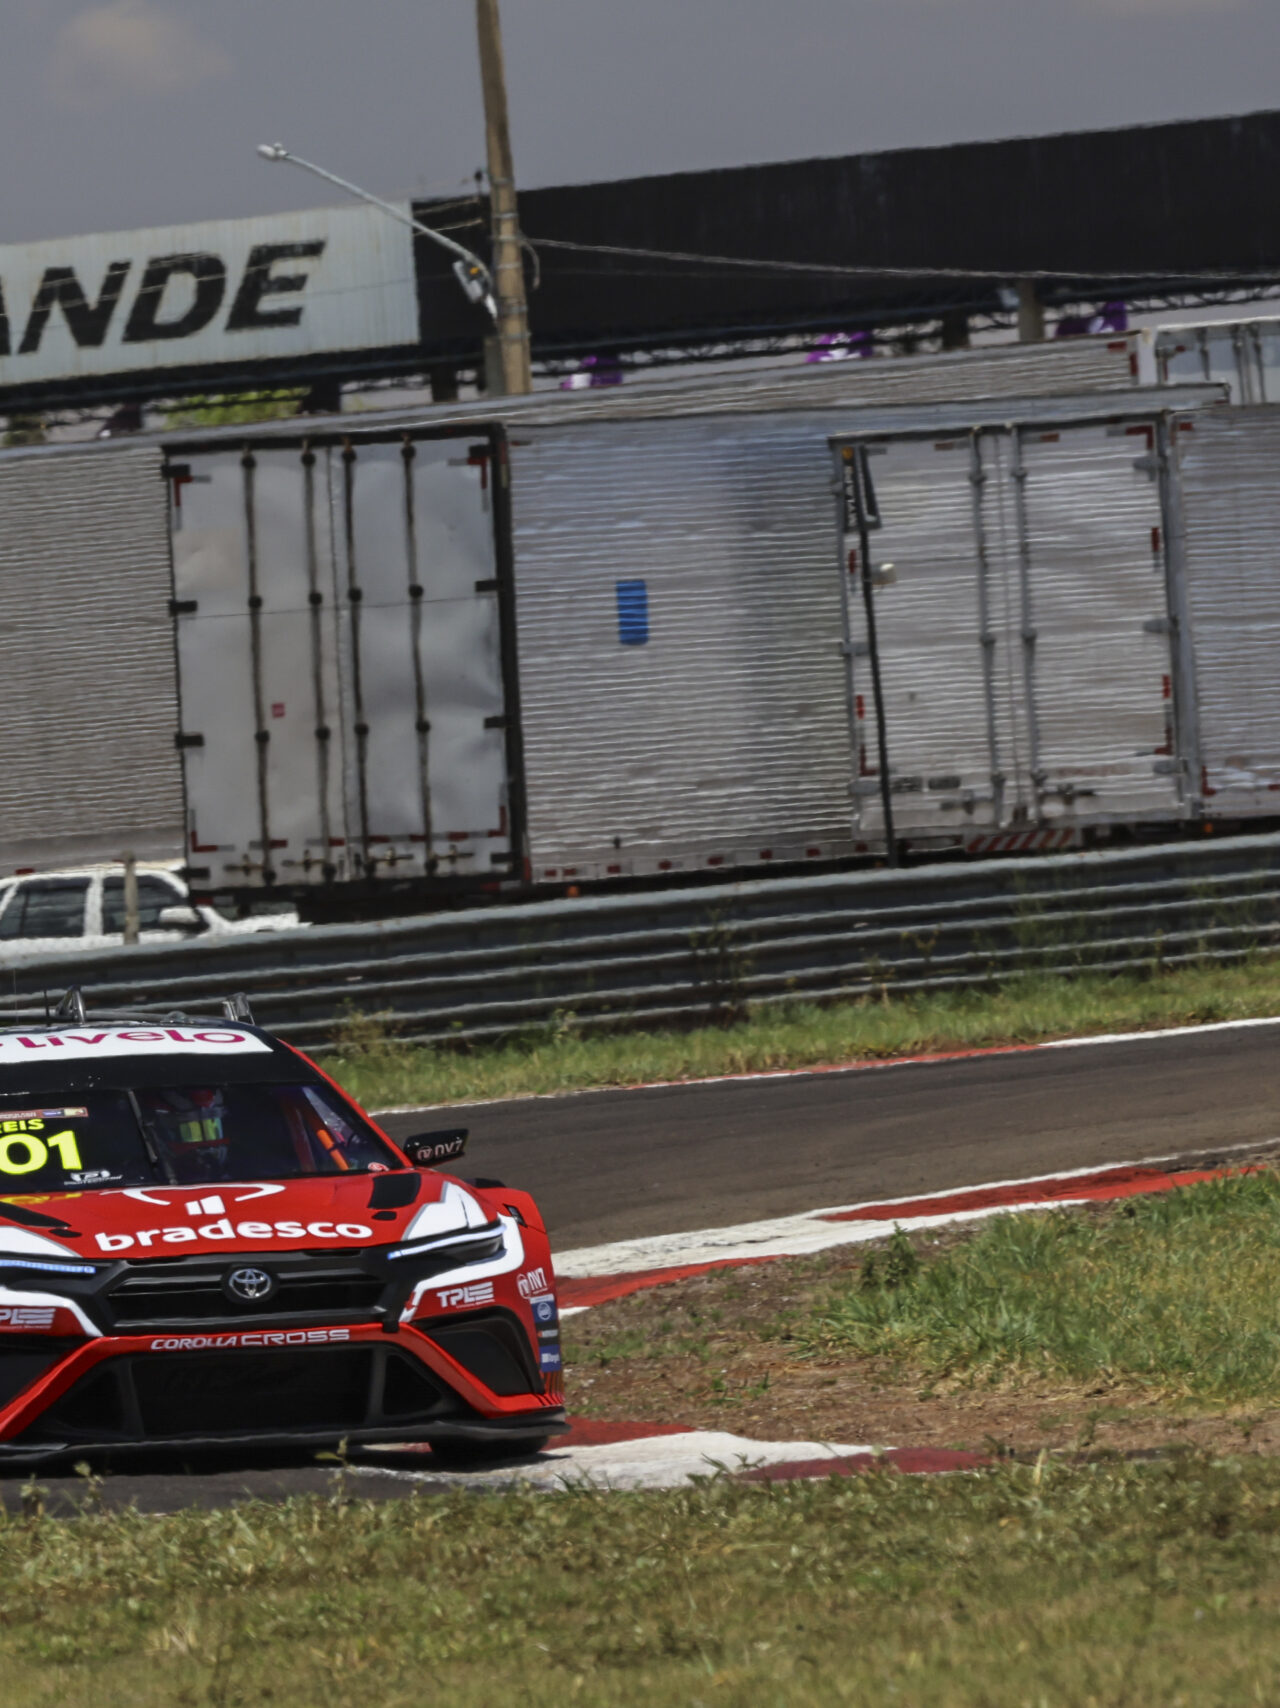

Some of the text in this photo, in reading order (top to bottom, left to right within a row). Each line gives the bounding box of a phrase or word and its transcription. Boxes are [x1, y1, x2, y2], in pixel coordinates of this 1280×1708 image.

[94, 1218, 373, 1252] bradesco
[151, 1328, 350, 1350] COROLLA CROSS
